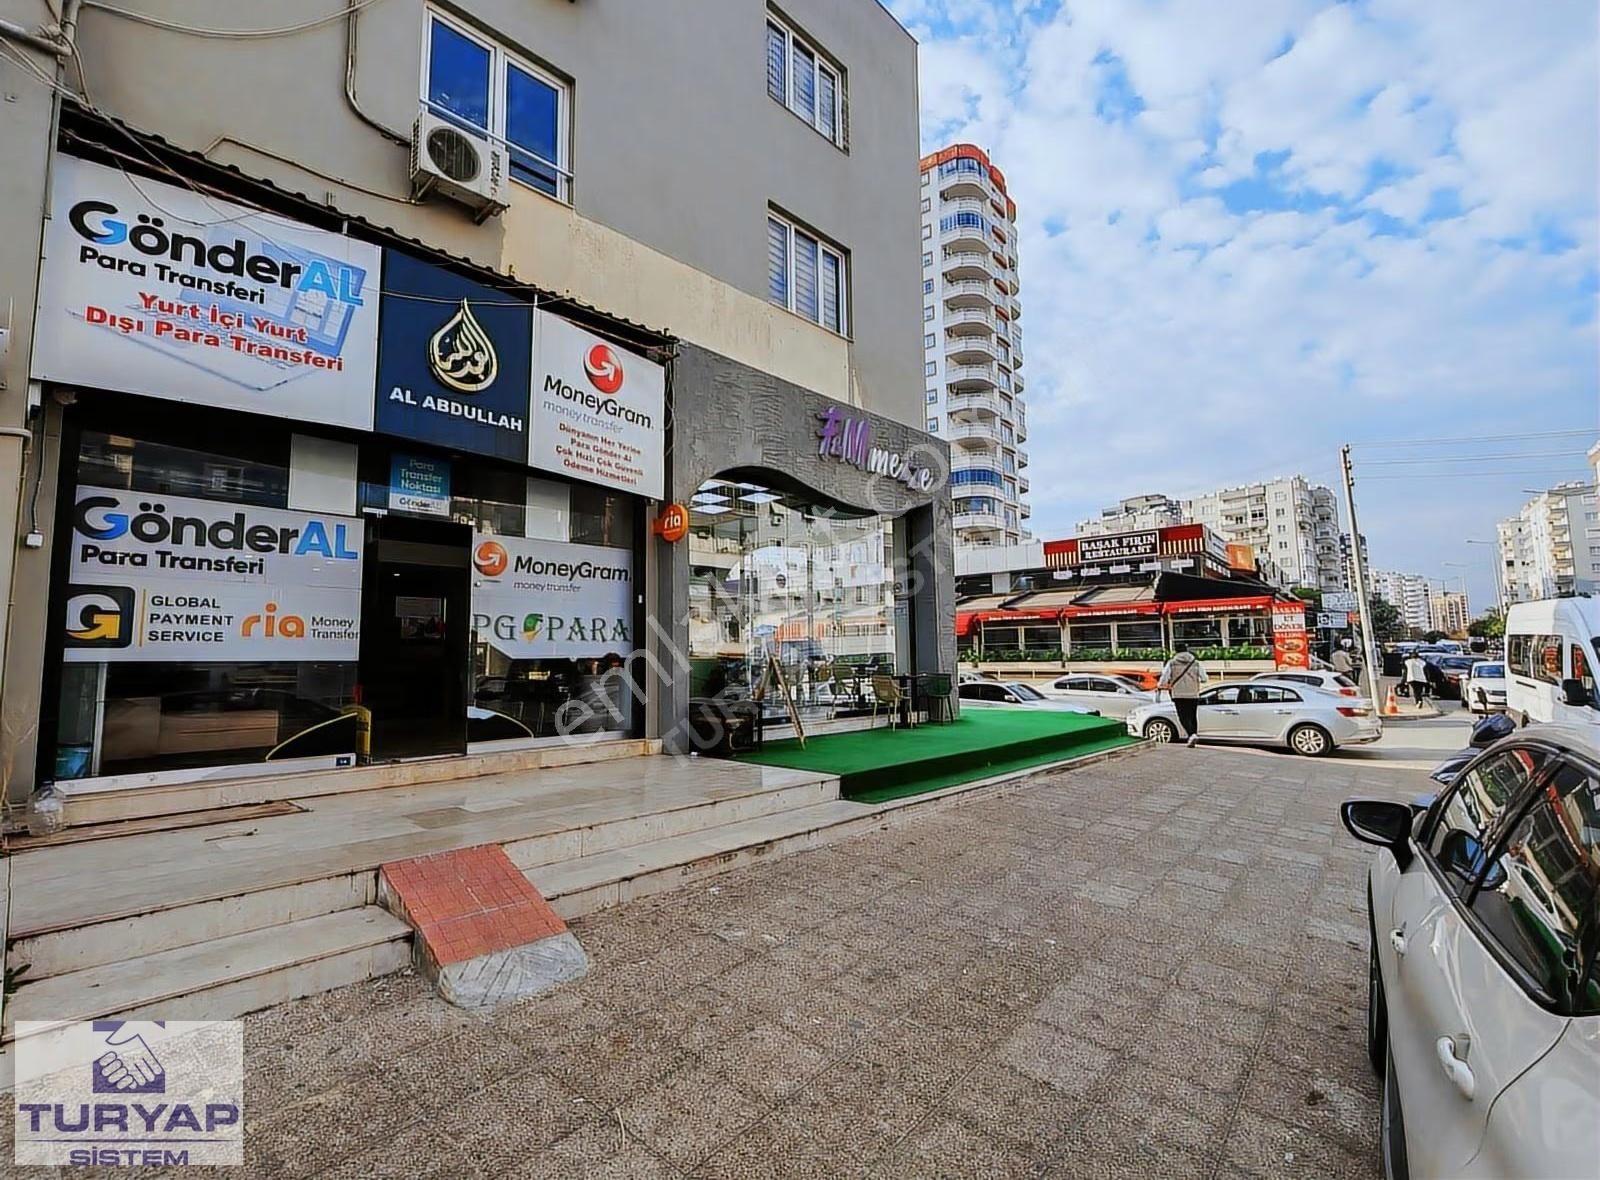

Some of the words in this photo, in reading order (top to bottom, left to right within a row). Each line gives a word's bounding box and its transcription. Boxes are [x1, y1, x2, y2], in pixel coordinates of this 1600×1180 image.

[69, 200, 364, 305] GönderAL
[80, 245, 146, 277] Para
[154, 262, 265, 304] Transferi
[139, 292, 199, 320] Yurt
[209, 304, 242, 329] İçi
[254, 317, 308, 343] Yurt
[85, 306, 143, 334] Dışı
[155, 319, 220, 347] Para
[231, 336, 343, 371] Transferi
[389, 387, 417, 406] AL
[422, 395, 523, 432] ABDULLAH
[543, 400, 582, 422] money
[582, 412, 624, 434] transfer
[72, 496, 359, 560] GönderAL
[664, 510, 681, 529] ria
[80, 544, 148, 567] Para
[155, 550, 264, 575] Transferi
[1084, 545, 1152, 559] RESTAURANT
[151, 595, 221, 609] GLOBAL
[514, 581, 546, 592] money
[546, 582, 581, 593] transfer
[150, 614, 234, 626] PAYMENT
[241, 602, 305, 638] ria
[311, 616, 354, 629] Money
[311, 629, 359, 641] Transfer
[148, 630, 224, 643] SERVICE
